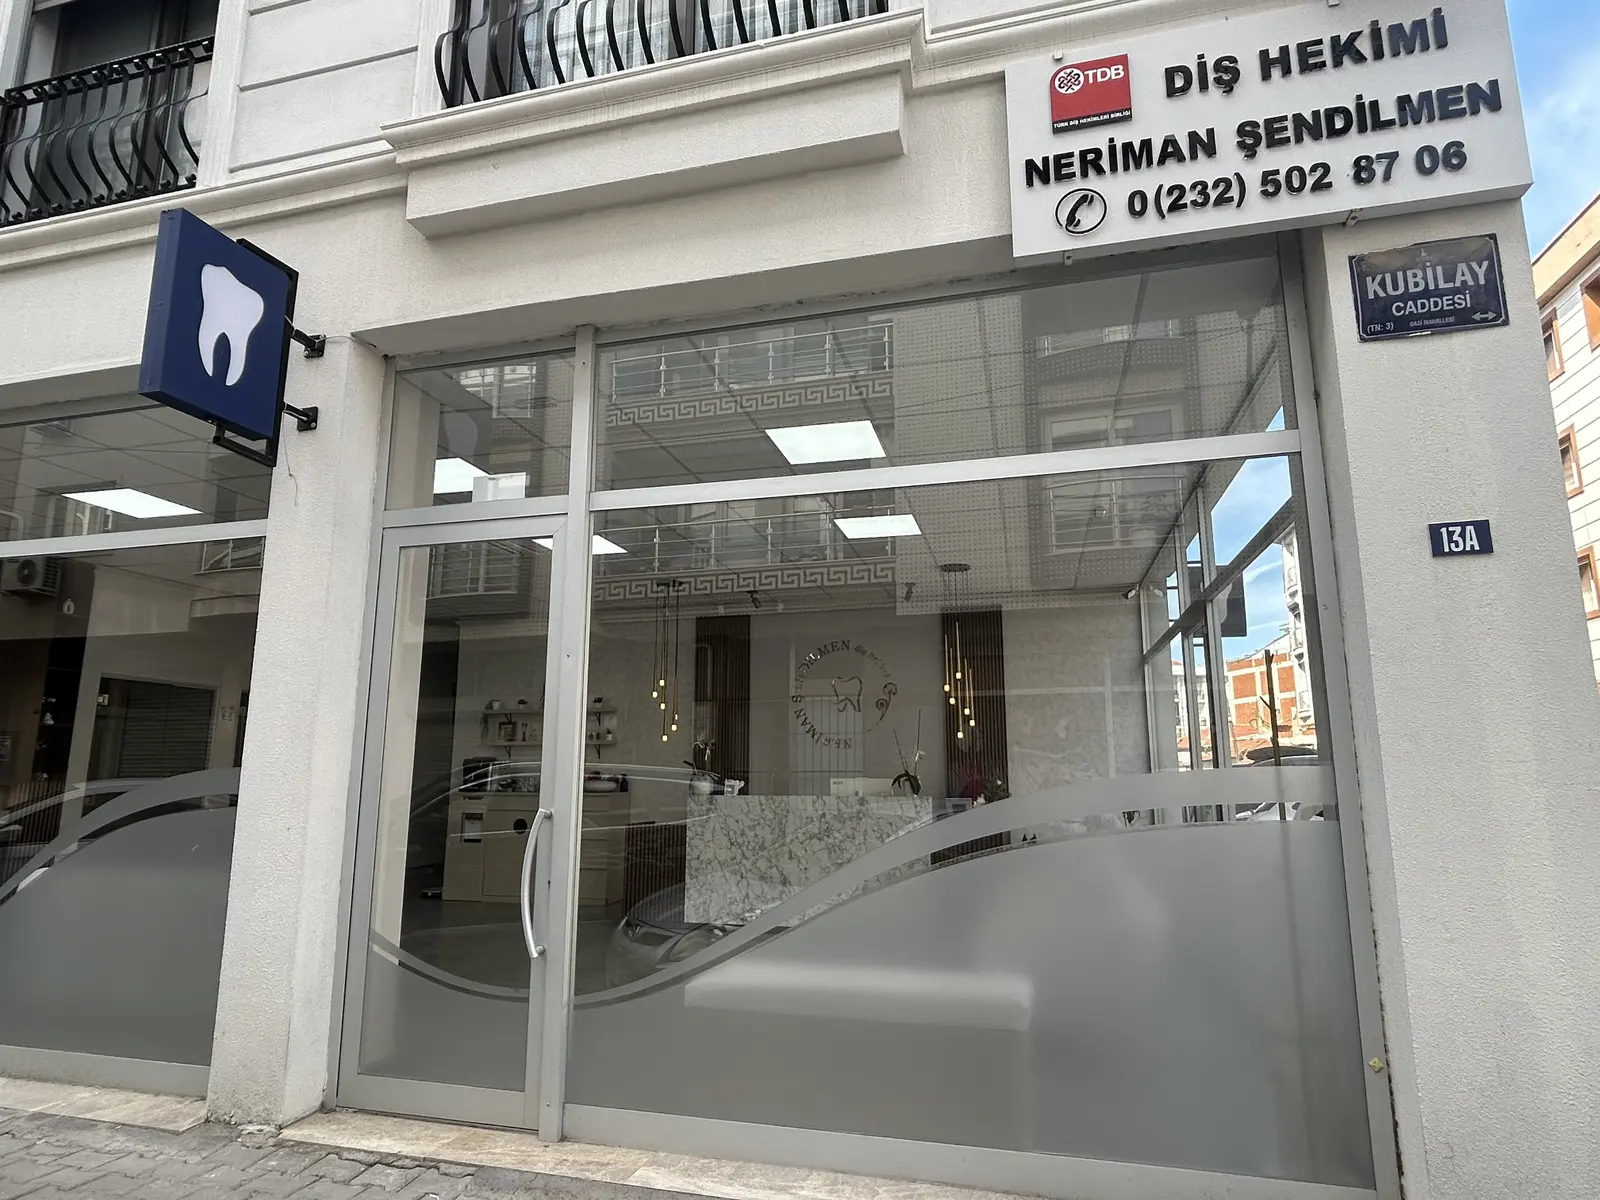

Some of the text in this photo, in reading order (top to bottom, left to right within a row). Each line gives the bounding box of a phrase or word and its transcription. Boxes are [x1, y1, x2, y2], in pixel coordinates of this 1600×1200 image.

[1165, 7, 1449, 98] DİŞ HEKİMİ
[1084, 64, 1125, 84] TDB
[1079, 114, 1109, 124] HEKİMLERİ
[1024, 79, 1502, 187] NERİMAN ŞENDİLMEN
[1127, 139, 1468, 220] 0(232) 502 87 06
[1365, 260, 1489, 300] KUBİLAY
[1391, 290, 1471, 316] CADDESİ
[1367, 321, 1394, 334] (TN: 3)
[1440, 525, 1480, 552] 13A
